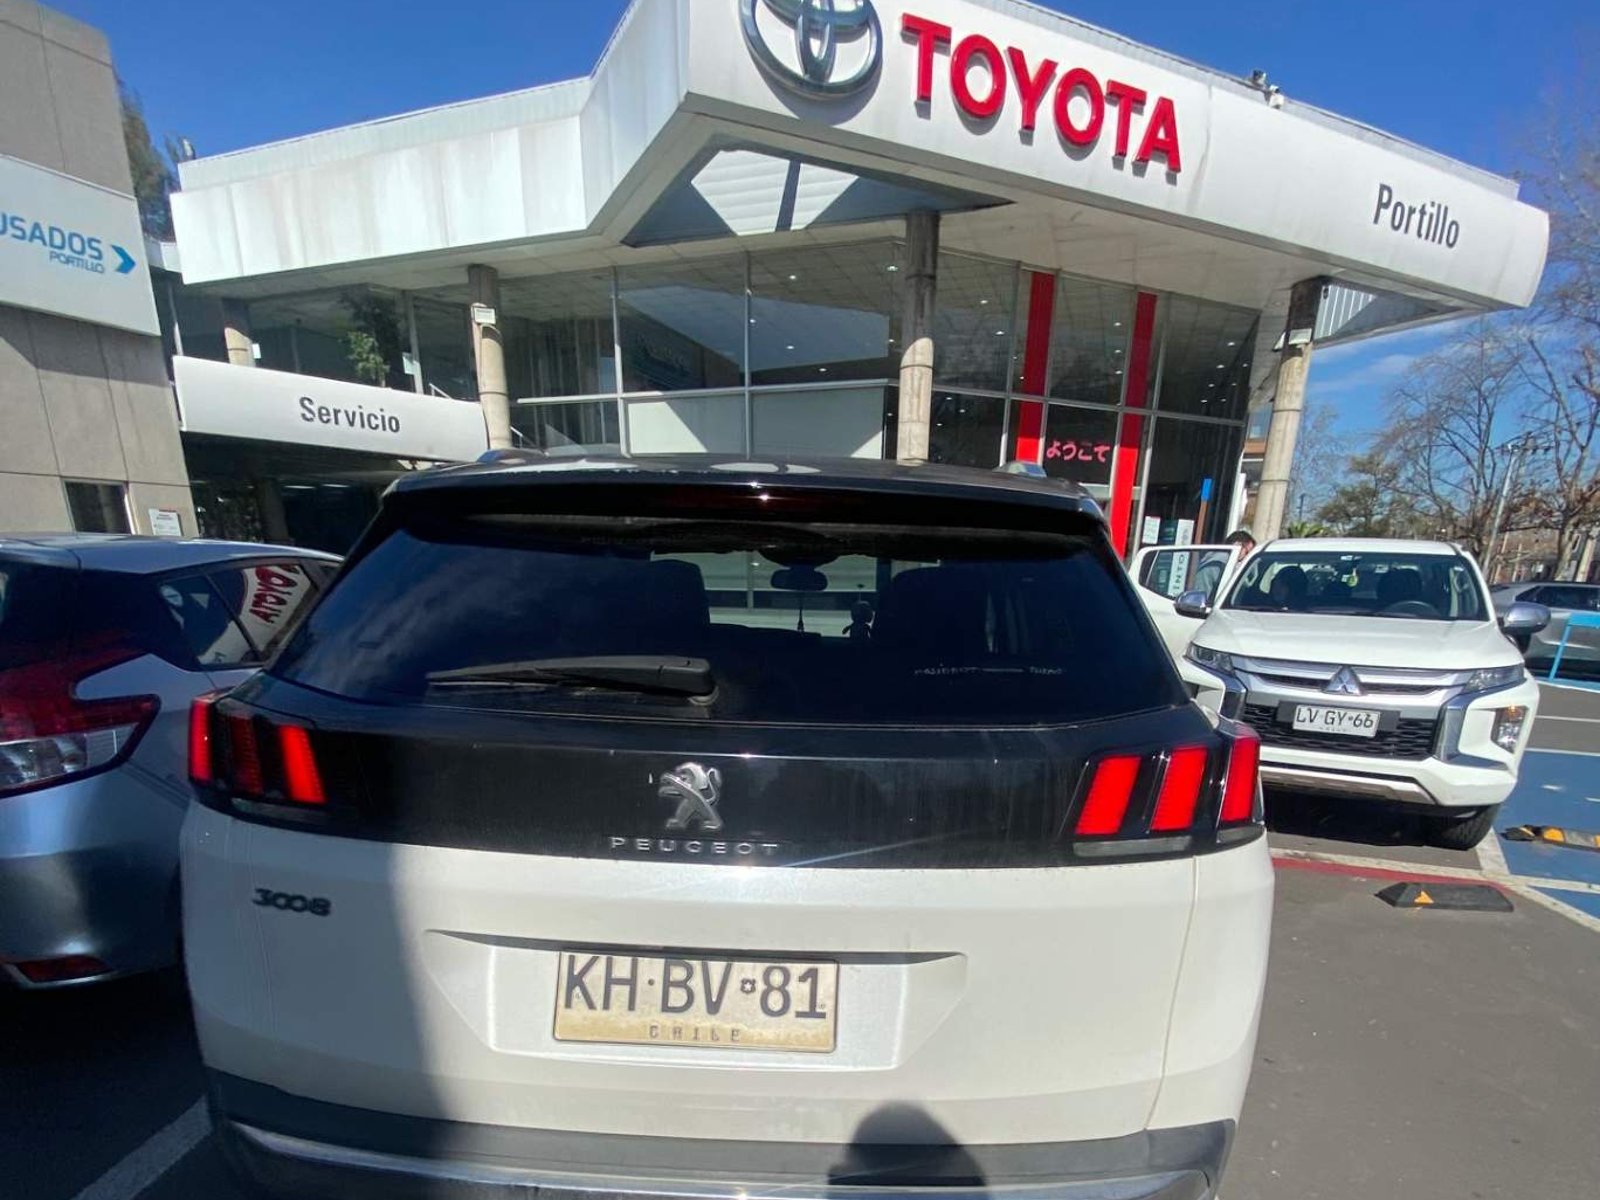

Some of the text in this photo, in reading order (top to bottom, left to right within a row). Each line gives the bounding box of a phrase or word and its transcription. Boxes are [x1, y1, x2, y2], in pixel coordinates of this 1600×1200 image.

[902, 13, 1181, 173] TOYOTA
[1373, 183, 1460, 248] Portillo
[50, 251, 104, 273] PORTILLO
[299, 396, 400, 433] Servicio
[609, 837, 778, 856] PEUGEOT
[252, 886, 331, 917] 3008
